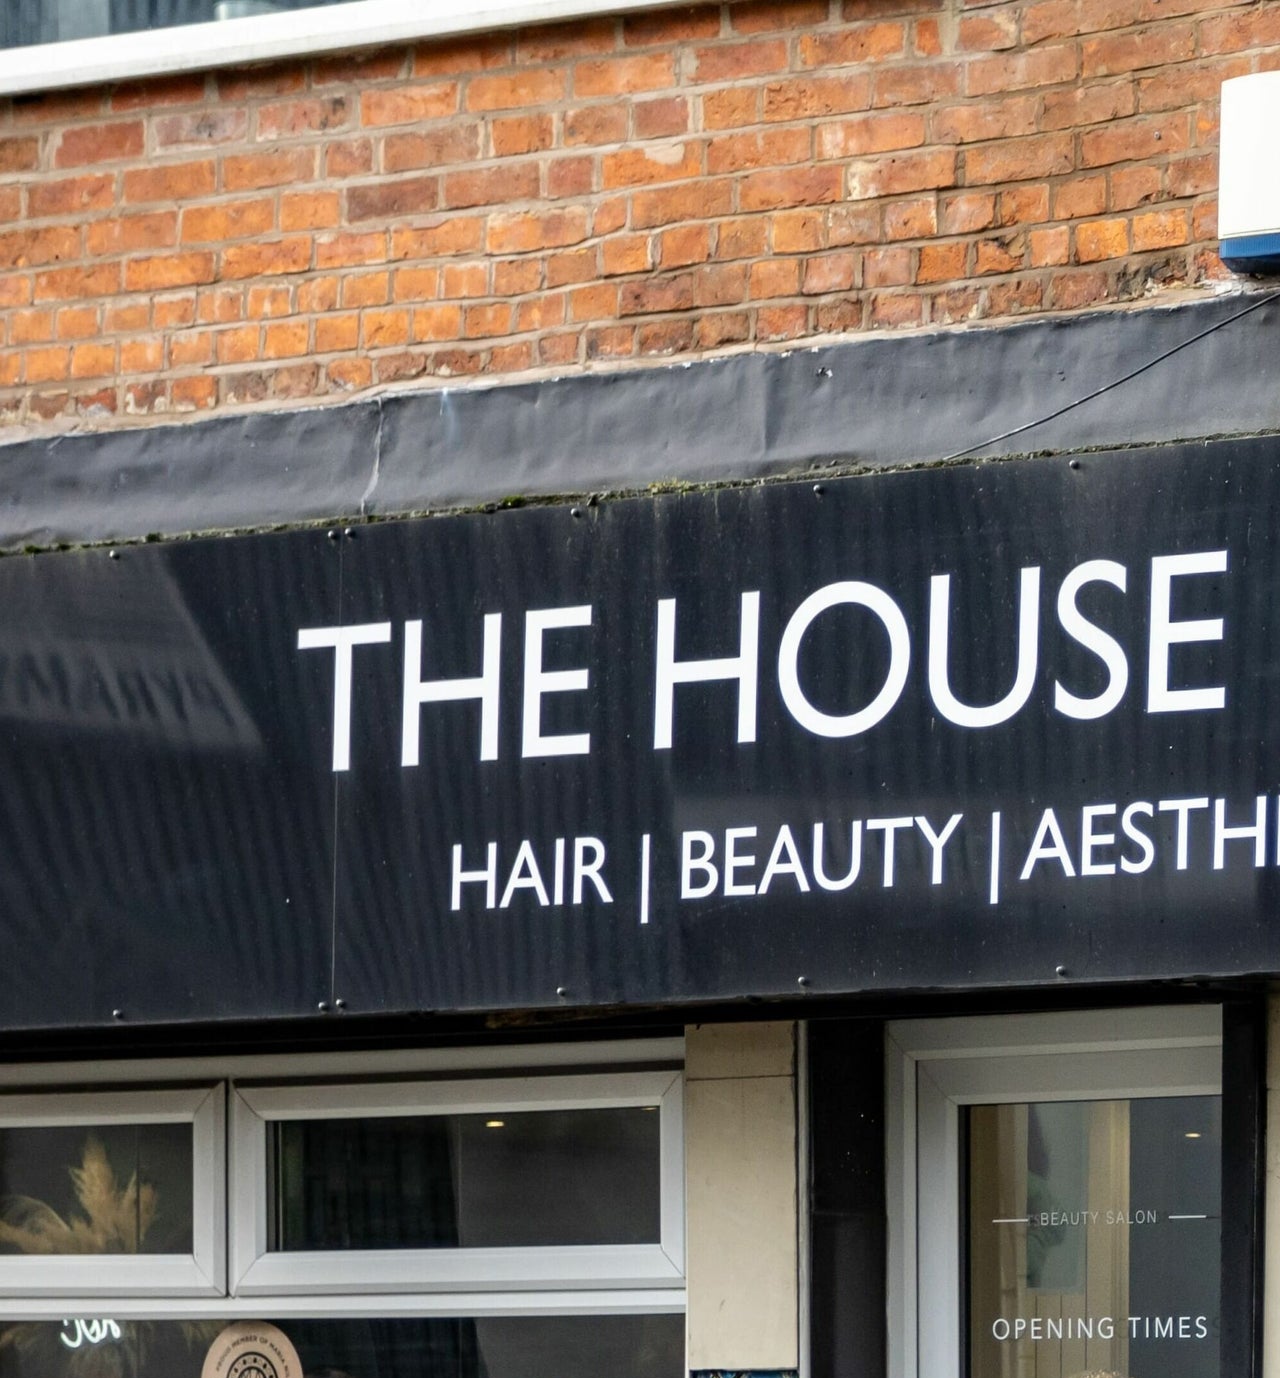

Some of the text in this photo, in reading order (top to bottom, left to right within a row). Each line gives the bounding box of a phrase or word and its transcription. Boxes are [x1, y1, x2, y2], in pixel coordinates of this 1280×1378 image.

[297, 604, 593, 772] THE
[653, 550, 1228, 750] HOUSE
[451, 836, 614, 911] HAIR
[680, 813, 964, 900] BEAUTY
[1040, 1211, 1099, 1226] BEAUTY
[1106, 1209, 1158, 1225] SALON
[992, 1315, 1208, 1340] OPENING TIMES
[231, 1335, 258, 1348] MEMBER
[259, 1336, 269, 1344] OF
